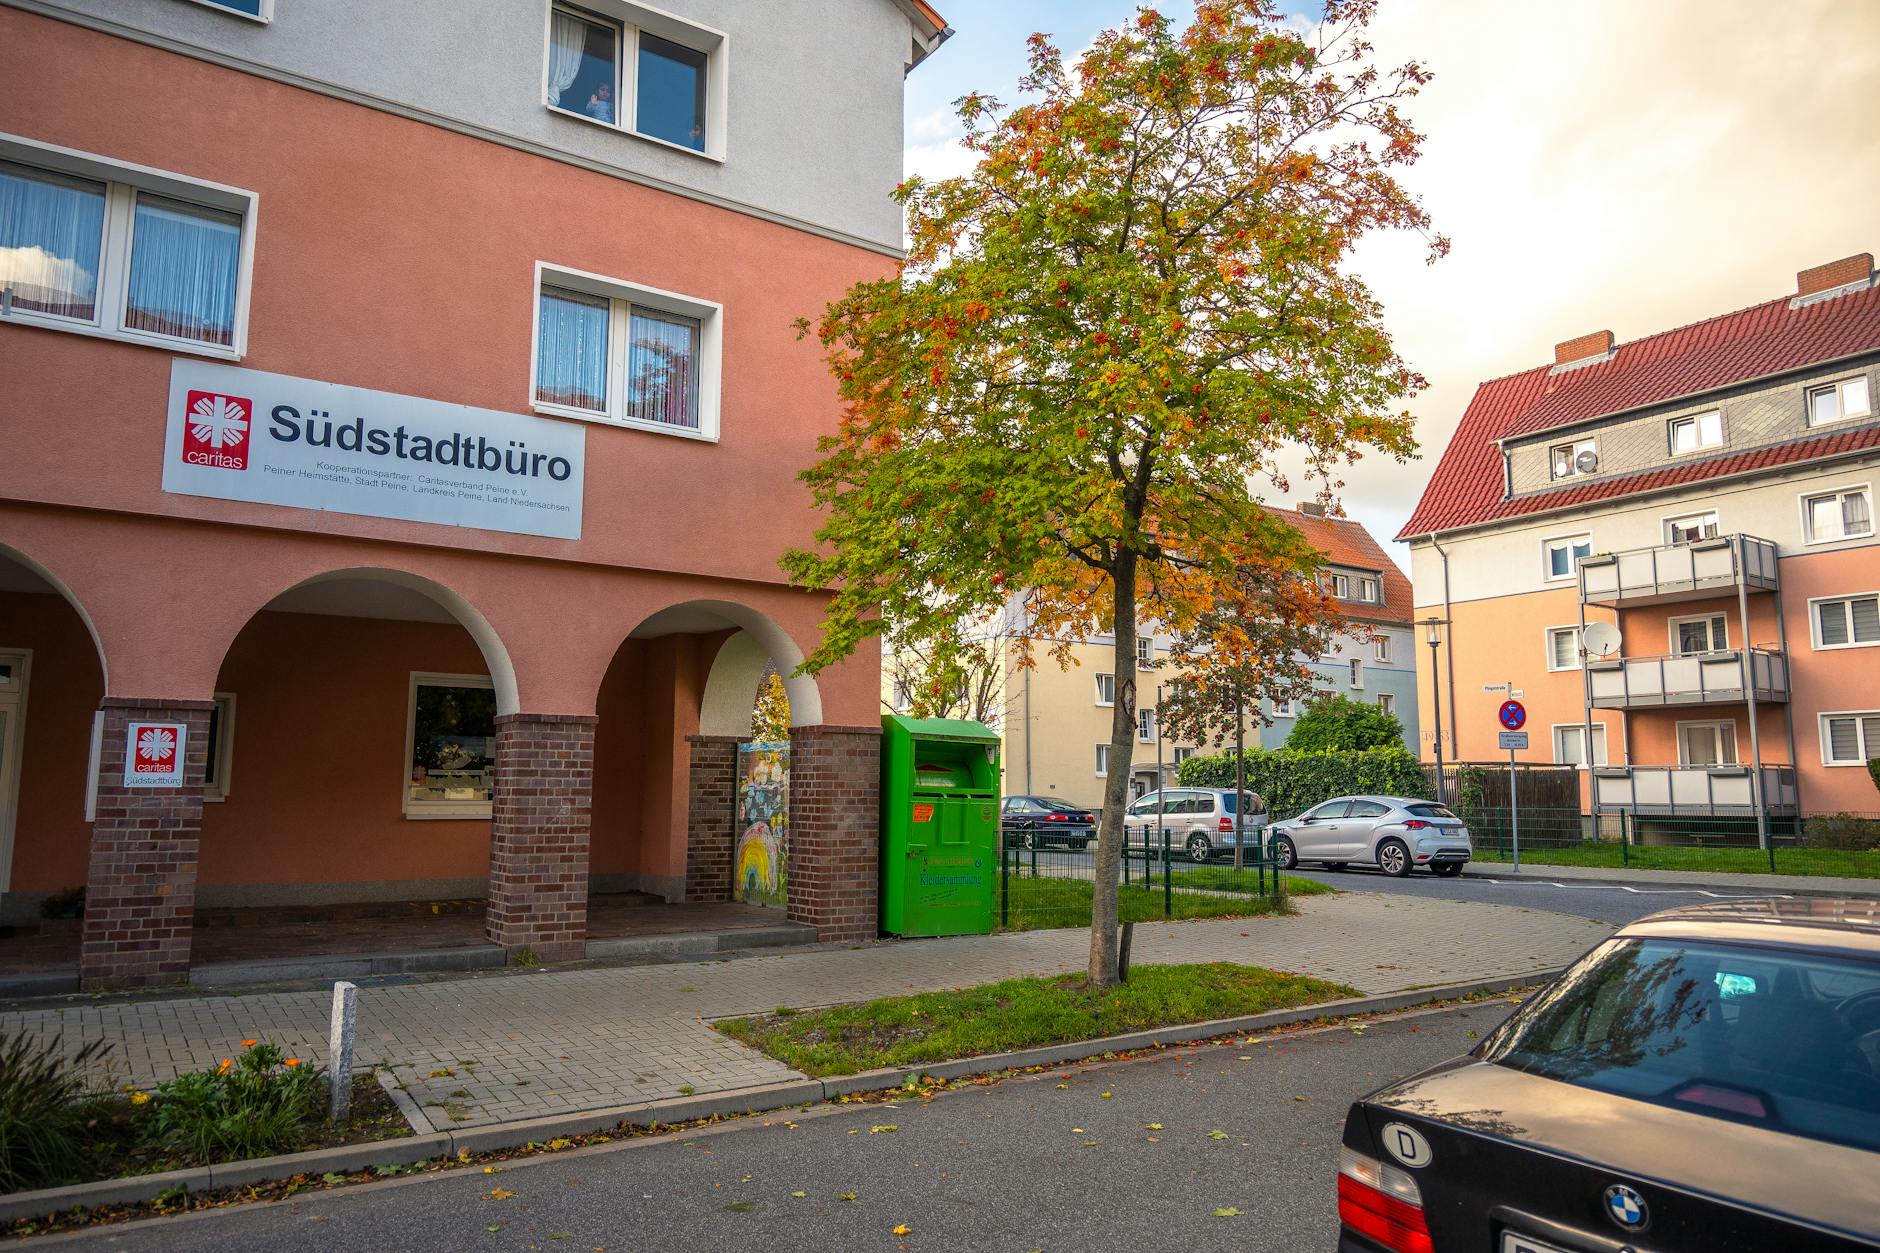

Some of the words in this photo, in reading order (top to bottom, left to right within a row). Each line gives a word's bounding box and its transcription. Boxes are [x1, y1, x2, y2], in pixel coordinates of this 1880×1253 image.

[269, 405, 572, 481] Südstadtbüro
[187, 451, 242, 468] caritas
[264, 464, 296, 475] Peiner
[299, 469, 352, 484] Heimstätte,
[355, 477, 379, 487] Stadt
[381, 480, 409, 492] Peine,
[413, 486, 455, 497] Landkreis
[458, 491, 485, 501] Peine,
[487, 495, 508, 504] Land
[510, 498, 570, 512] Niedersachsen
[316, 461, 412, 482] Kooperationspartner:
[419, 475, 483, 491] Caritasverband
[486, 485, 510, 495] Peine
[126, 776, 181, 784] Südstadtbüro
[137, 763, 172, 772] caritas
[1398, 1130, 1416, 1159] D
